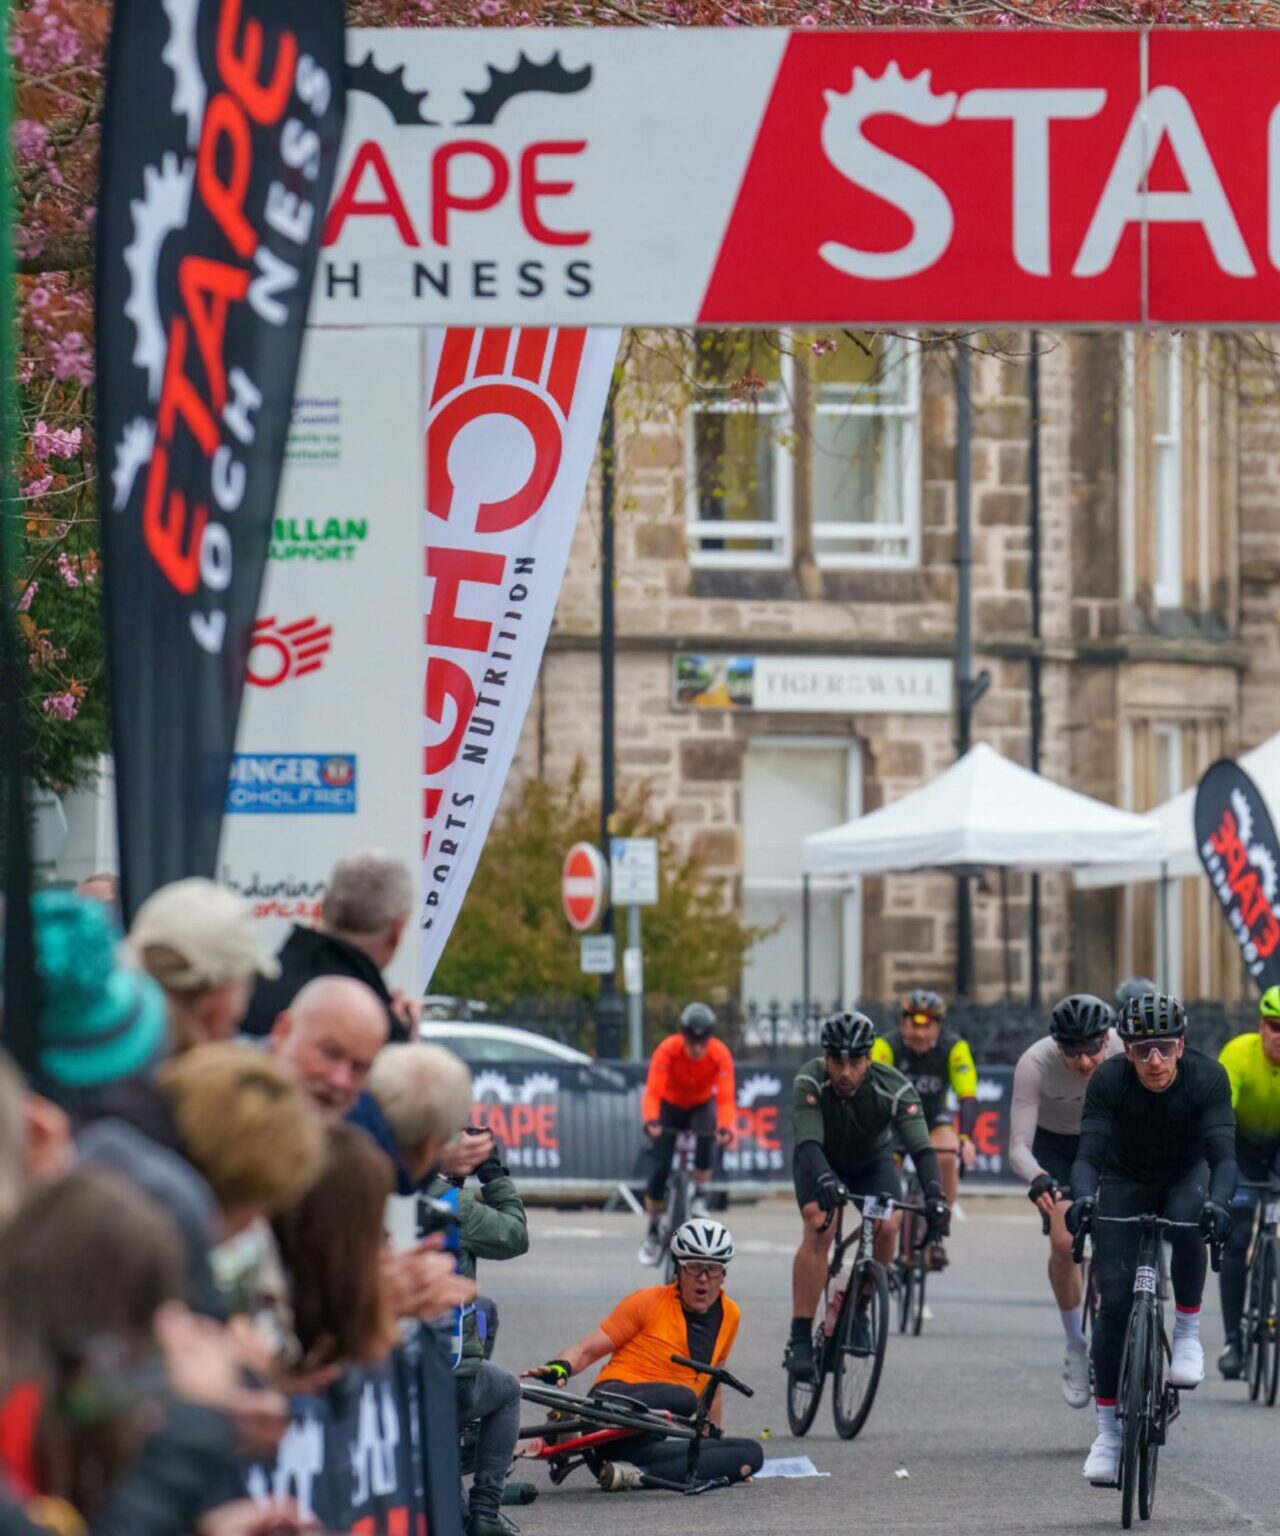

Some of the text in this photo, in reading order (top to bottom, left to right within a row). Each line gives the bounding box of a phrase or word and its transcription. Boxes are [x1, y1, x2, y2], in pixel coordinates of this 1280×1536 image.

[320, 138, 592, 248] APE
[143, 0, 298, 595] ETAPE
[413, 261, 593, 298] NESS
[189, 53, 331, 655] LOCH NESS
[273, 518, 369, 542] ILLAN
[766, 673, 844, 695] TIGER
[231, 757, 321, 787] INGER
[471, 1104, 560, 1149] TAPE
